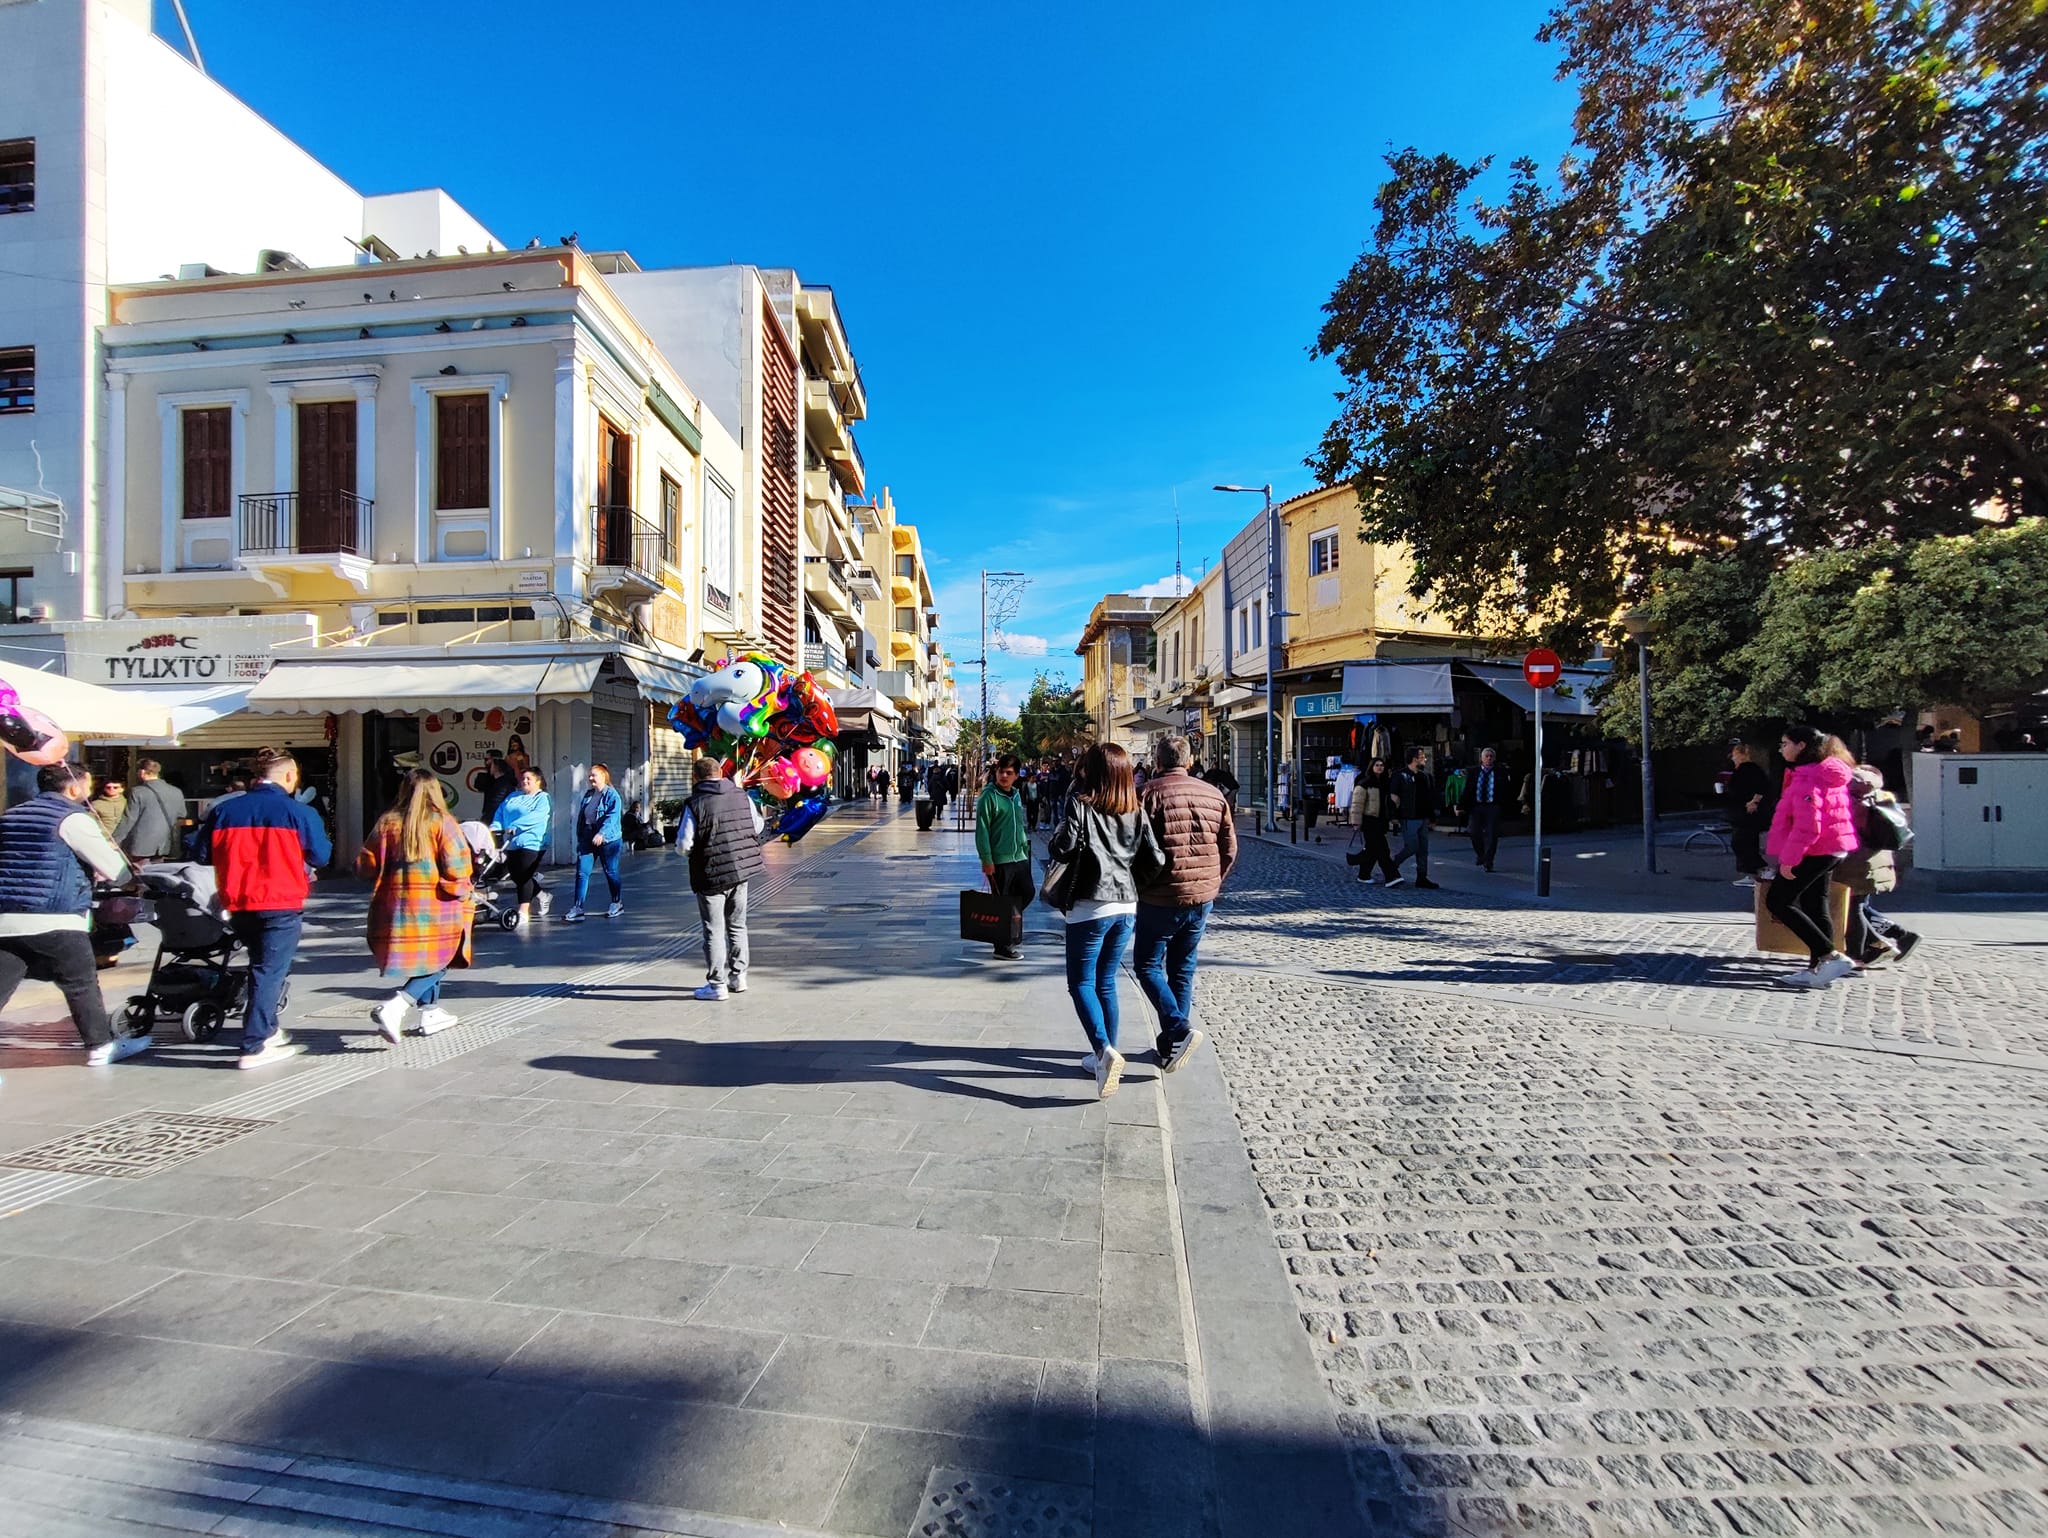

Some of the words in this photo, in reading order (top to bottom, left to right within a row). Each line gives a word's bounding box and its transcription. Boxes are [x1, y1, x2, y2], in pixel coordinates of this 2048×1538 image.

[105, 656, 216, 679] TYLIXTO
[234, 661, 264, 669] STREET
[474, 740, 495, 749] ΕΙΔΗ
[465, 751, 487, 760] ΤΑΞΙ
